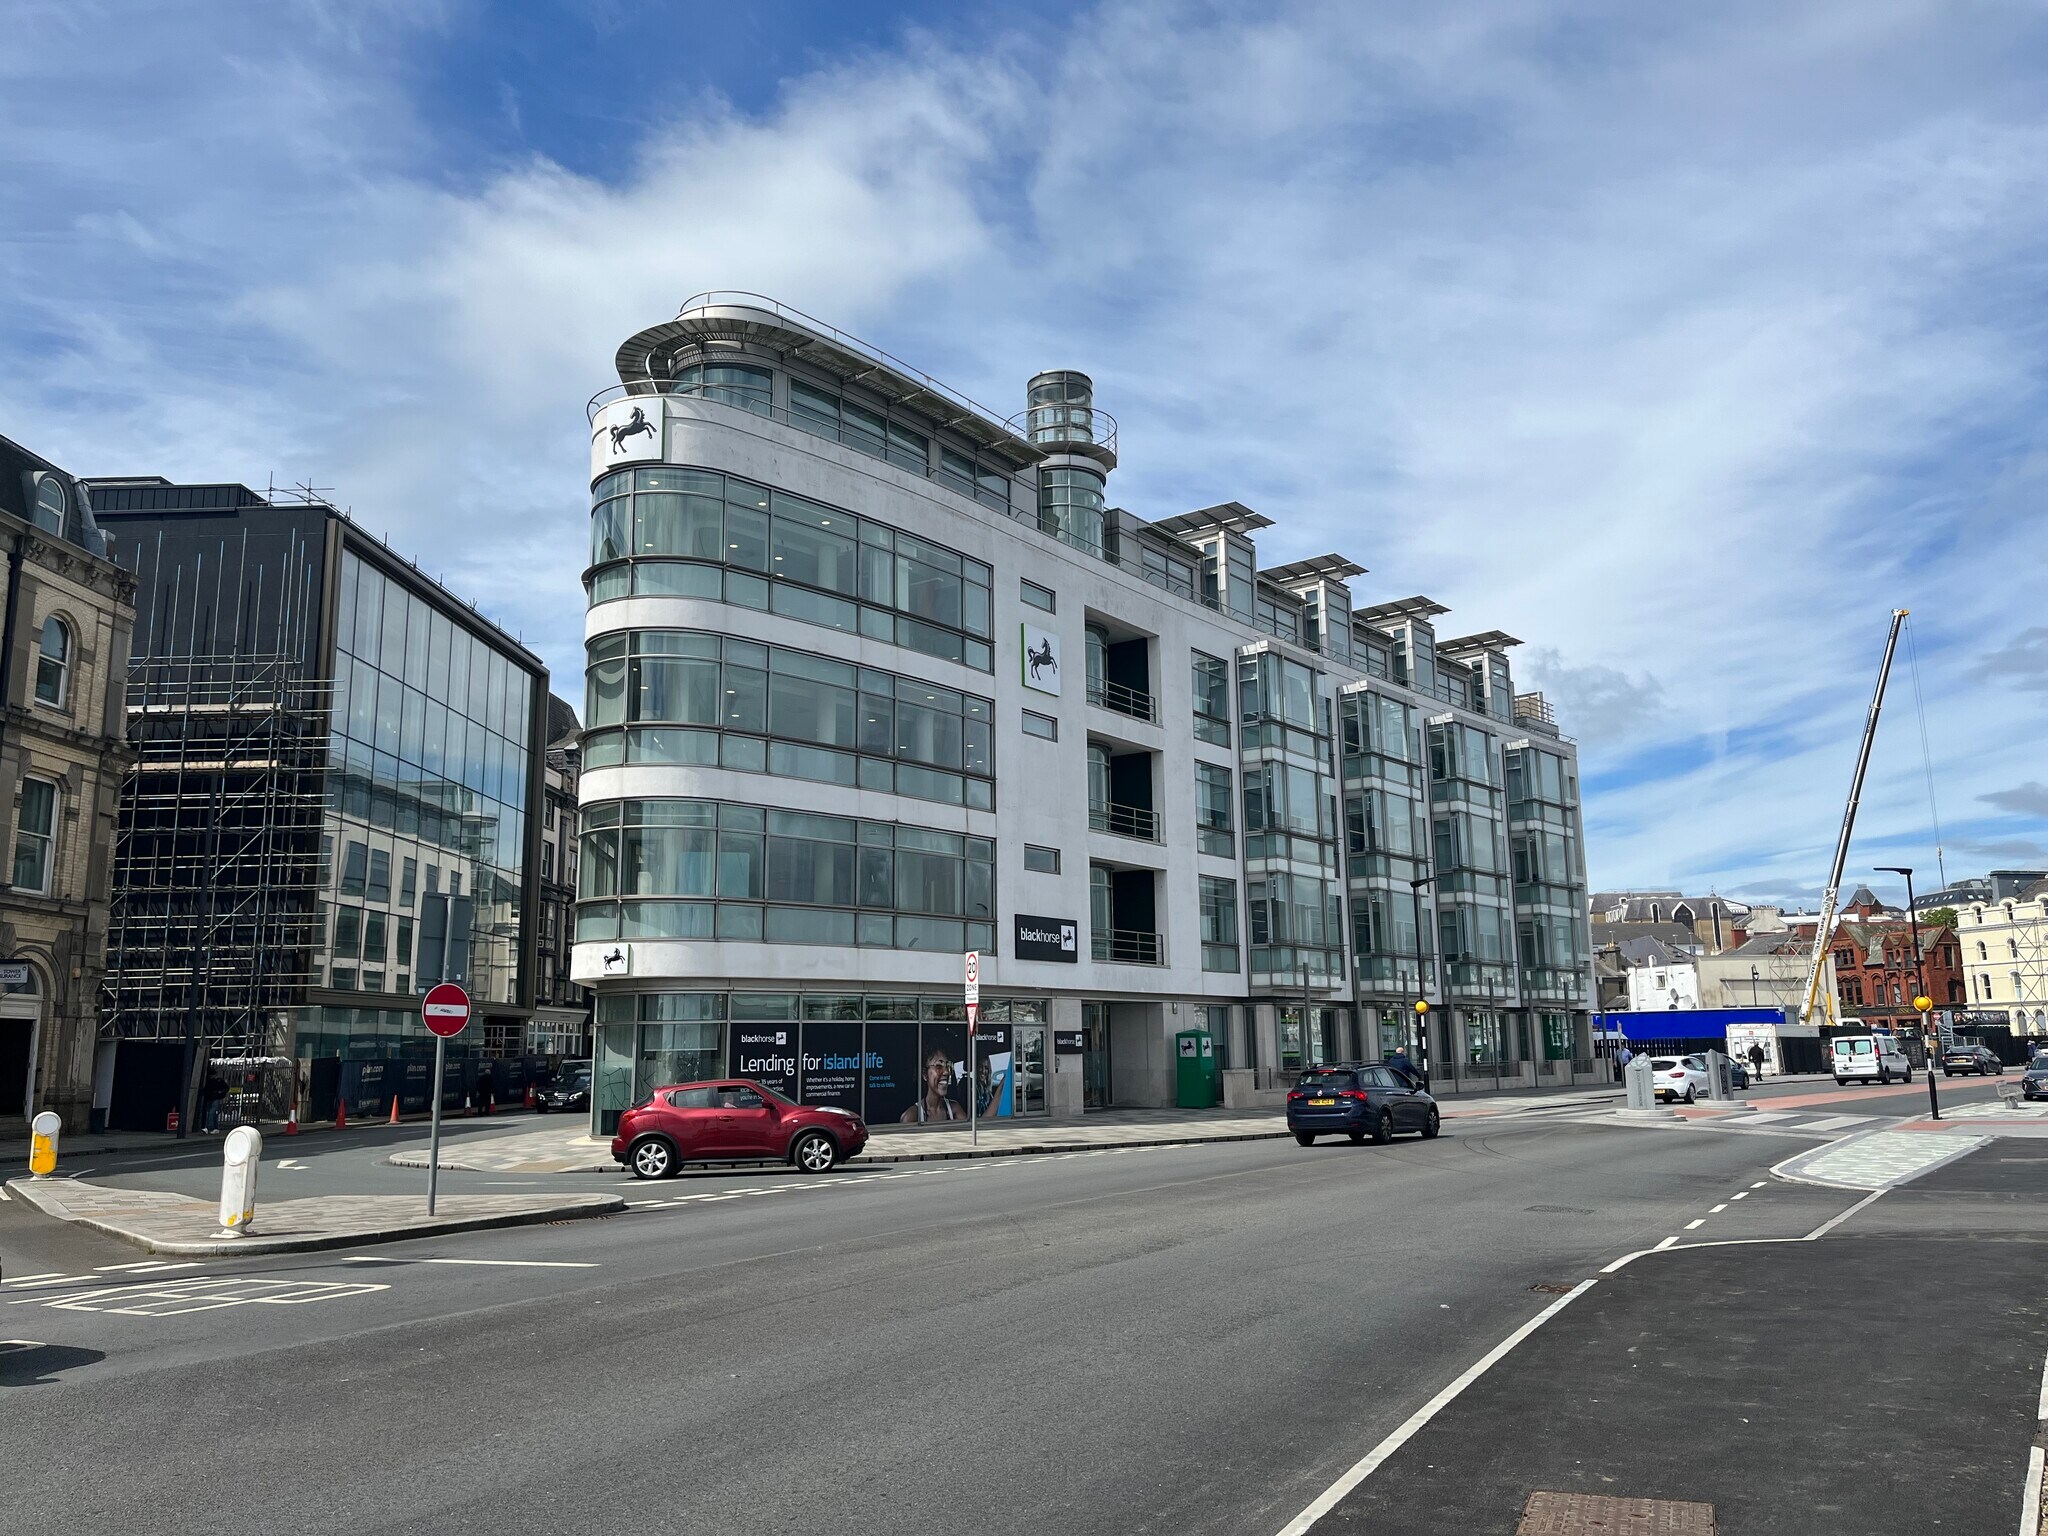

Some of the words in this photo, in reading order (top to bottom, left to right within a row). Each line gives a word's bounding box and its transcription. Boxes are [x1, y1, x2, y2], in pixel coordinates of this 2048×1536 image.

[1020, 927, 1060, 943] blackhorse
[968, 962, 976, 973] 20
[741, 1034, 775, 1043] blackhorse
[976, 1033, 997, 1041] blackhorse
[406, 1063, 427, 1074] plan.com
[740, 1054, 795, 1076] Lending
[802, 1053, 821, 1070] for
[823, 1053, 860, 1070] island
[866, 1052, 883, 1069] life
